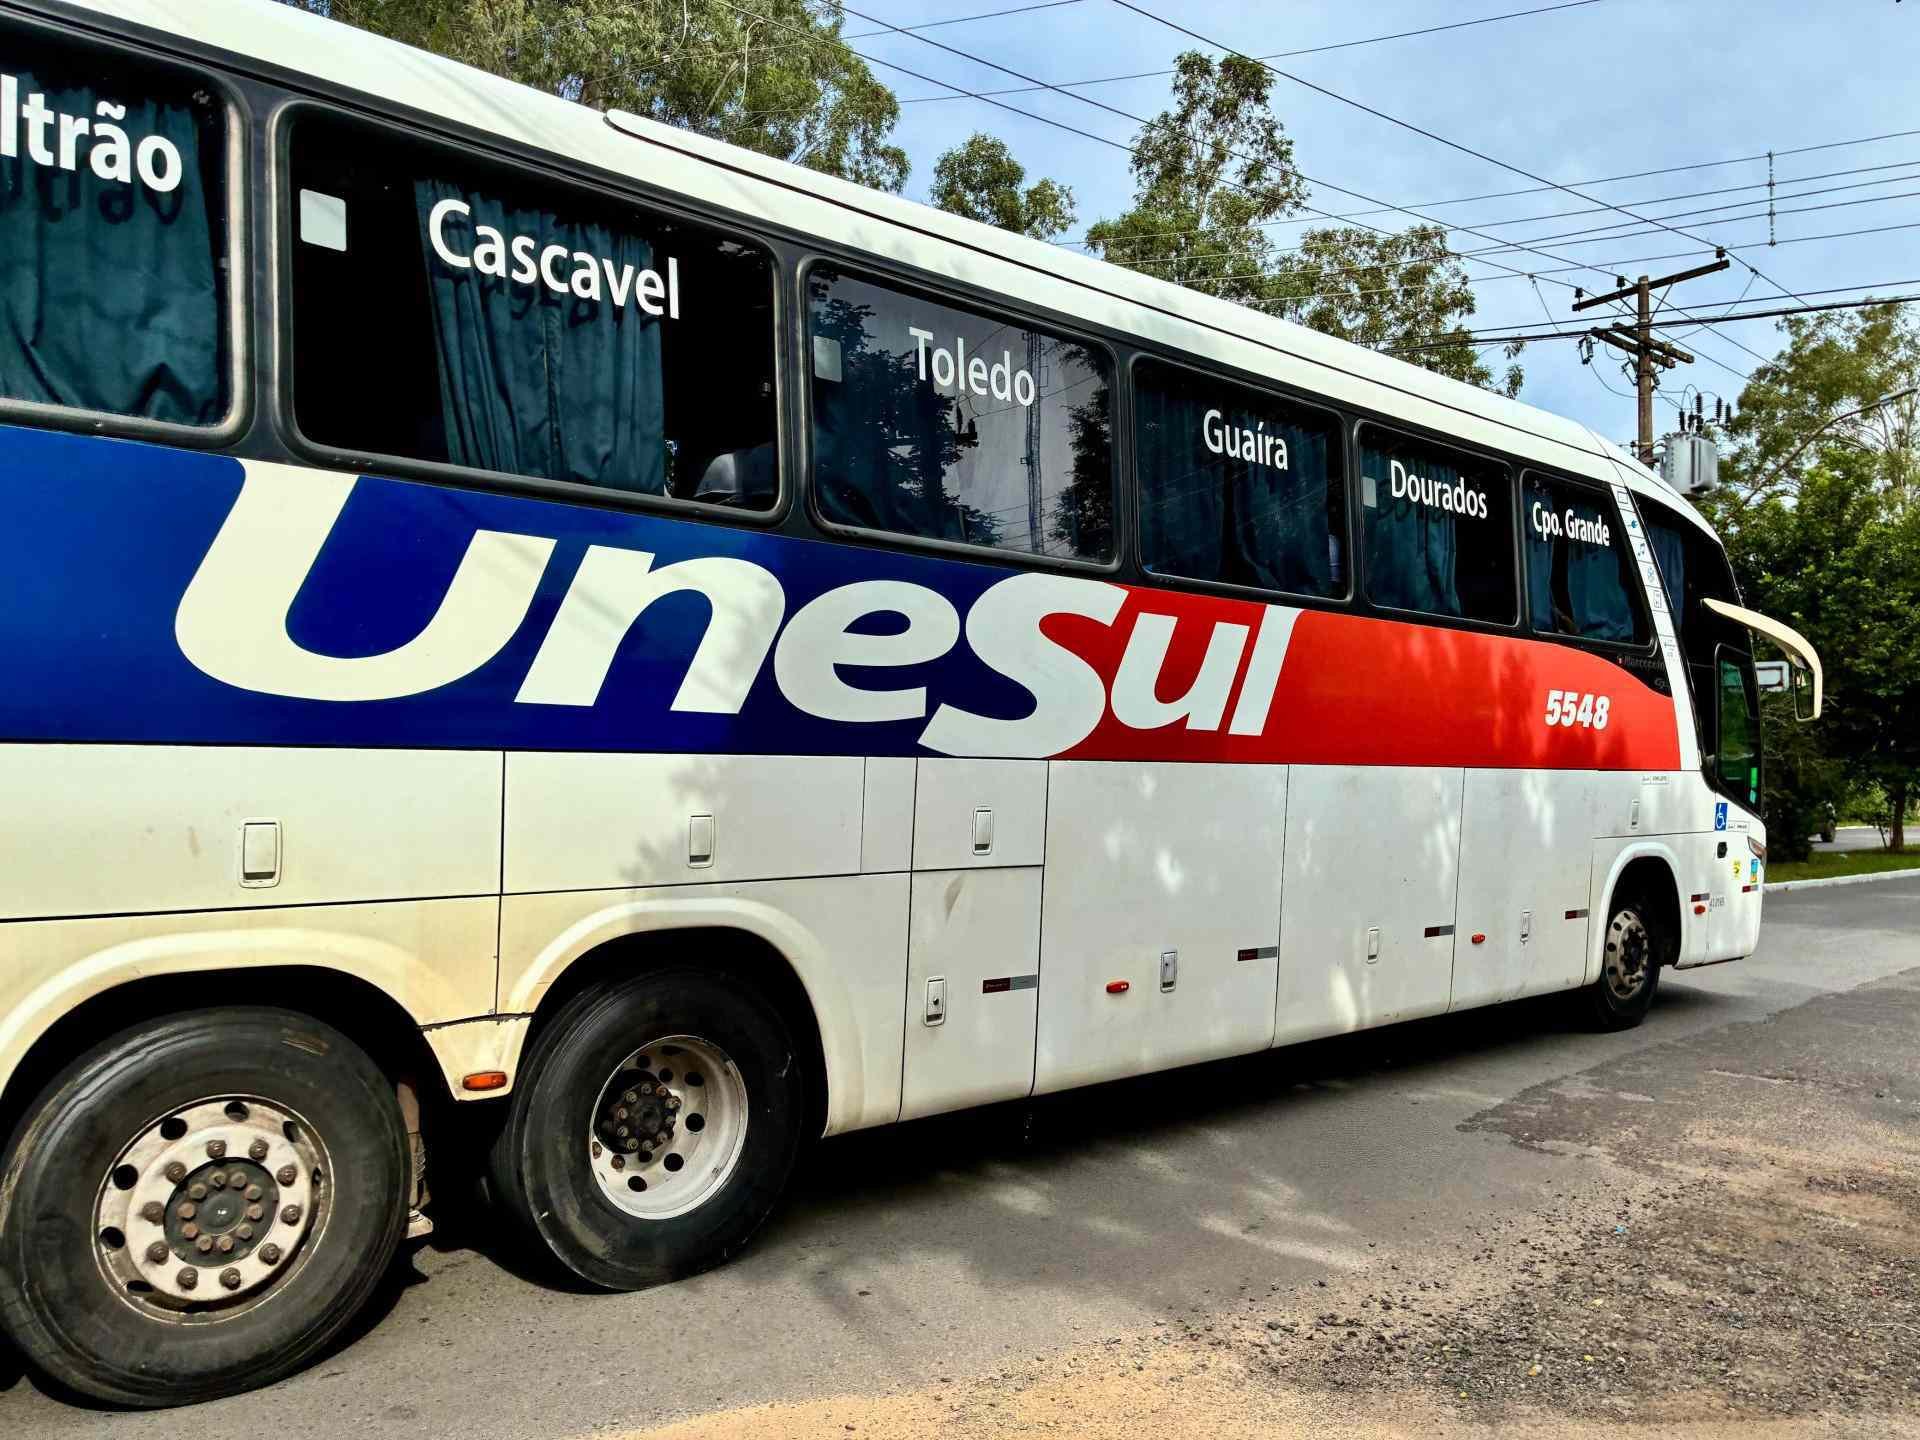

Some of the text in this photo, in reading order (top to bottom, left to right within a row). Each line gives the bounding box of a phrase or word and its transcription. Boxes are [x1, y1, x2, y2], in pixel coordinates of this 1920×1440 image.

[429, 198, 680, 320] Cascavel
[909, 326, 1036, 410] Toledo
[1203, 409, 1288, 471] Guaíra
[1390, 459, 1488, 519] Dourados
[1532, 501, 1610, 547] Cpo. Grande
[1545, 689, 1610, 730] 5548
